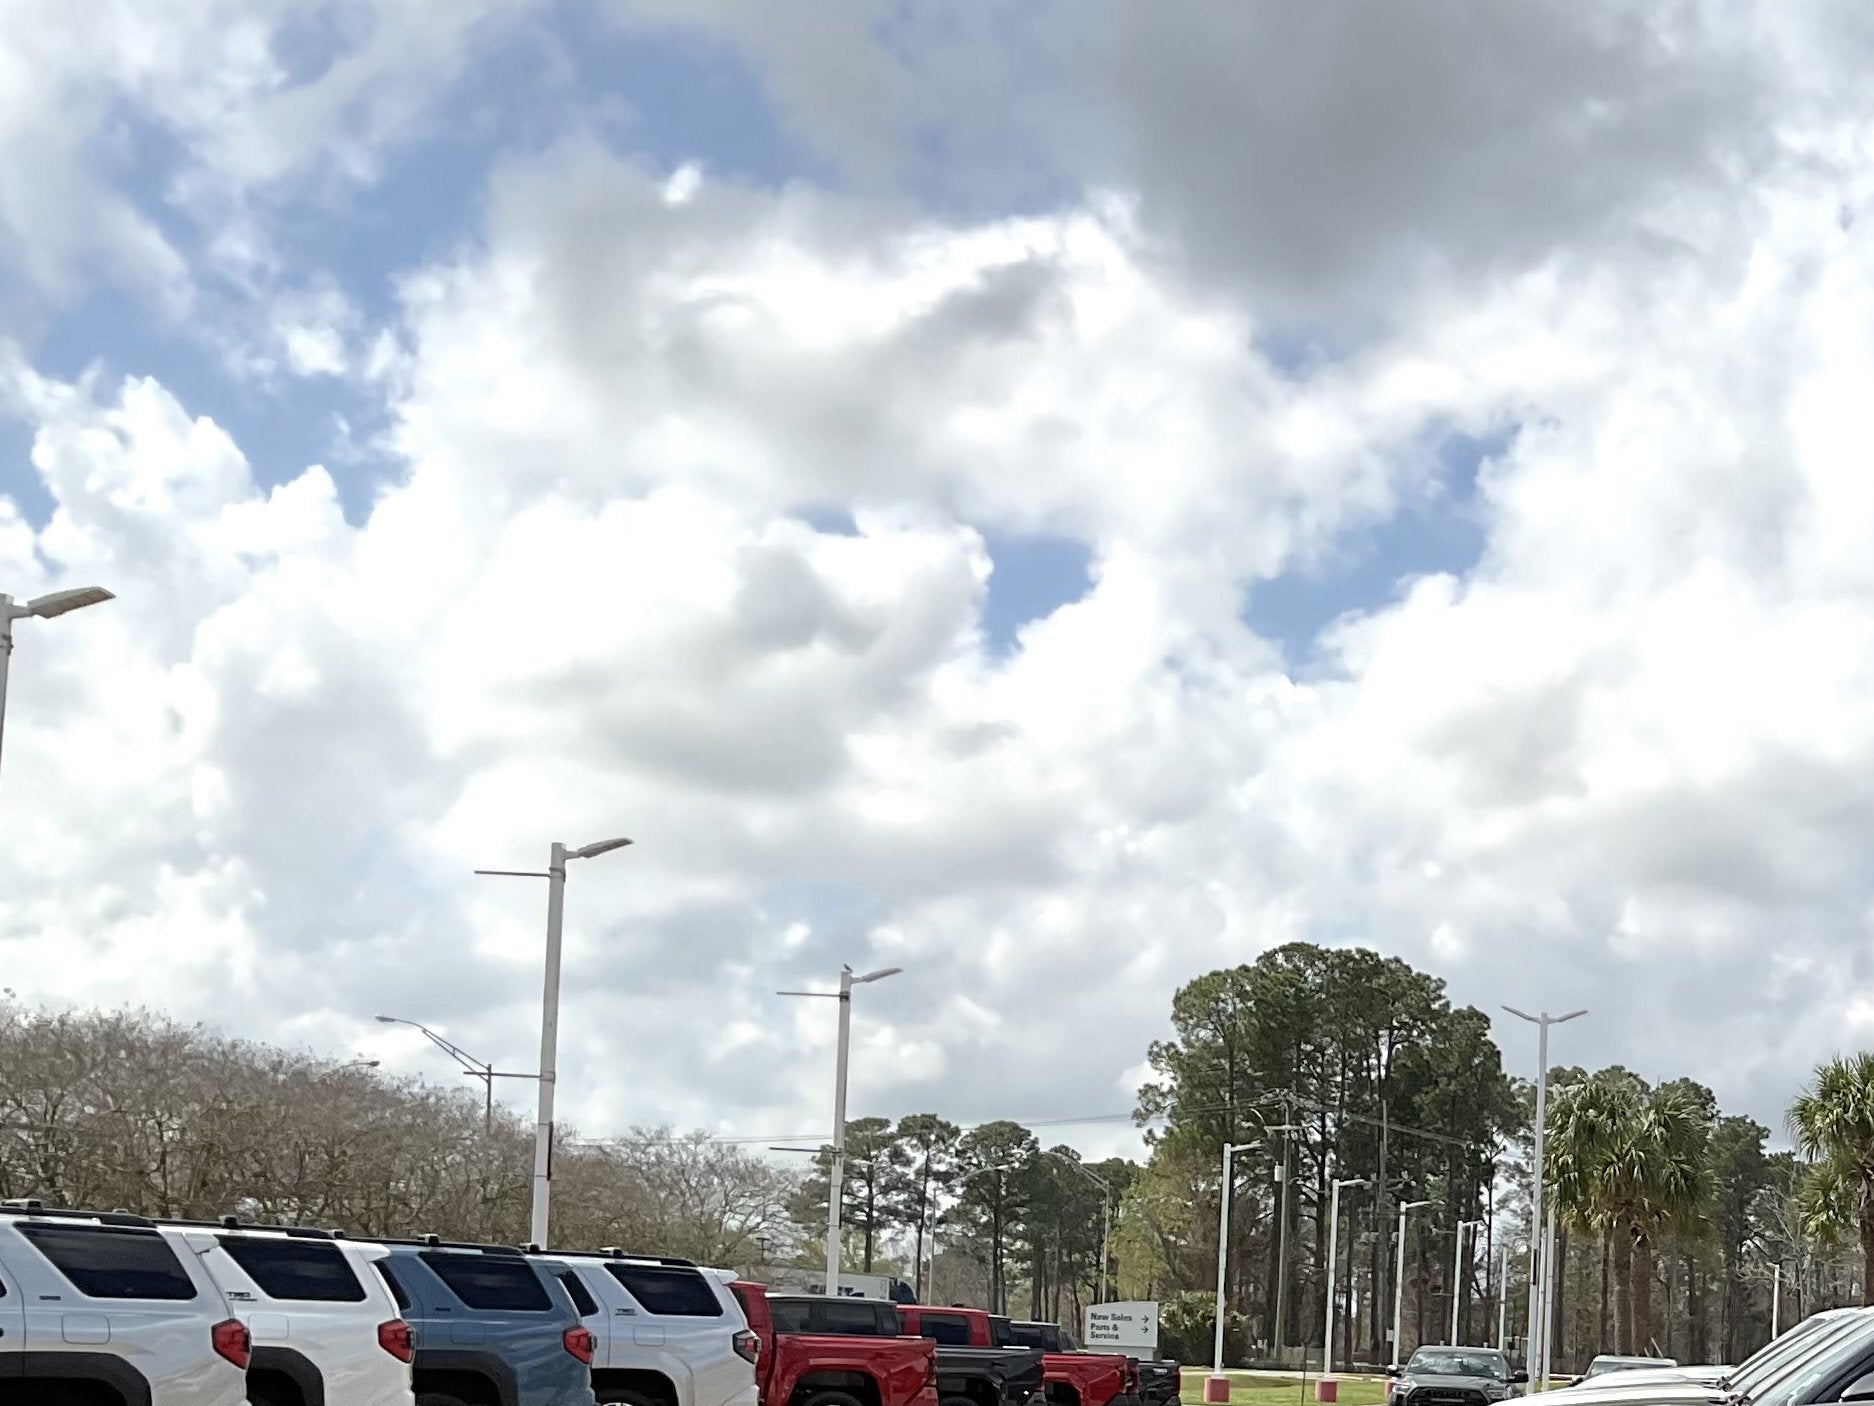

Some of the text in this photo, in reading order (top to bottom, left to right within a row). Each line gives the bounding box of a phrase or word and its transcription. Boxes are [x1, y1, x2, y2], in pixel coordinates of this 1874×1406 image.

[1111, 1313, 1132, 1321] Sales
[1090, 1323, 1119, 1331] Parts &
[1090, 1331, 1119, 1340] Service
